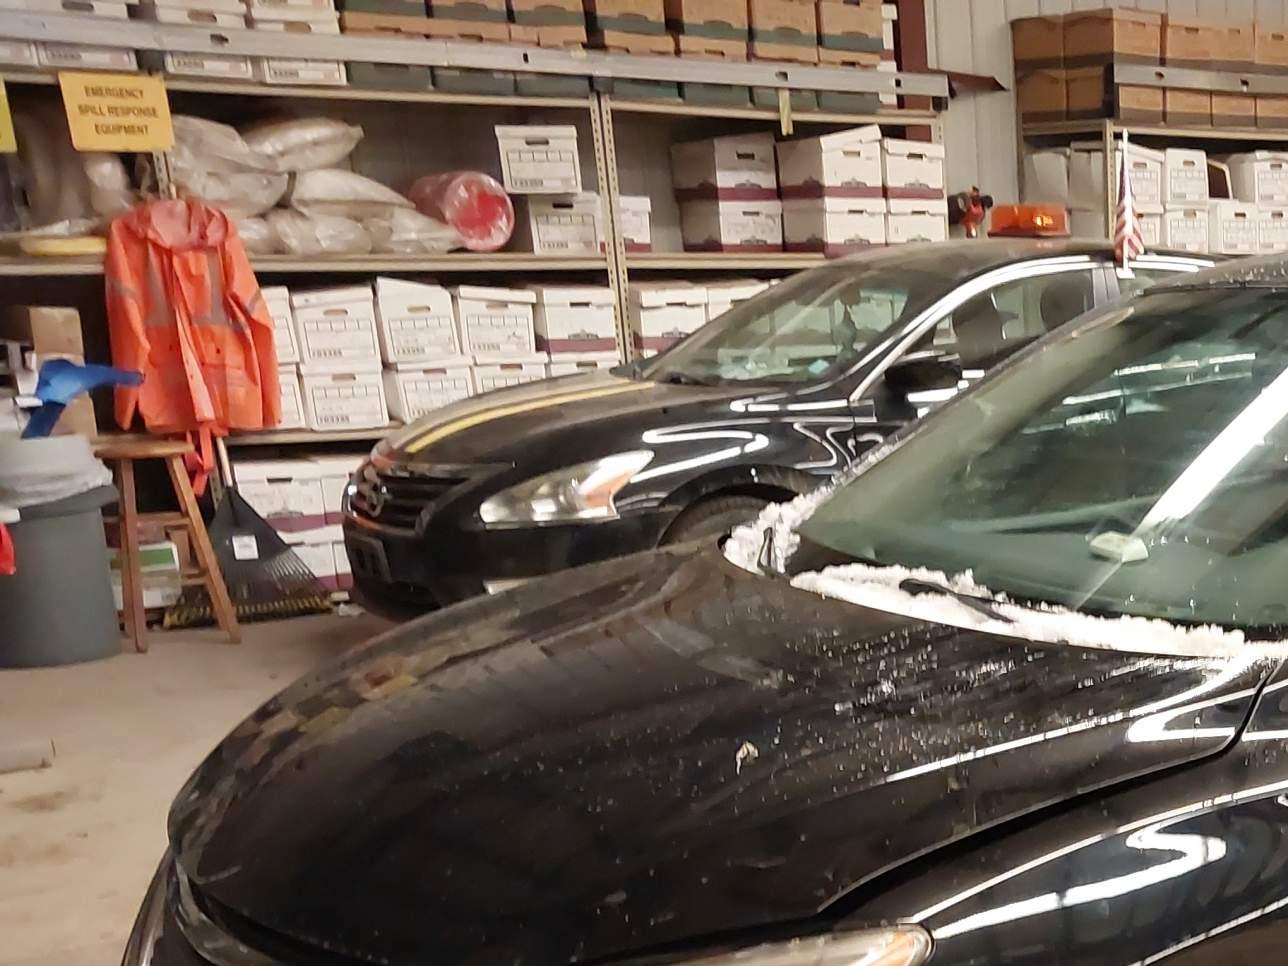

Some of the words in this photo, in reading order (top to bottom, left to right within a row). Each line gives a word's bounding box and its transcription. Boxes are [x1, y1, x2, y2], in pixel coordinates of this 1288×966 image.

[84, 85, 144, 99] EMERGENCY
[78, 104, 105, 117] SPILL
[107, 105, 159, 118] RESPONSE
[94, 123, 149, 135] EQUIPMENT
